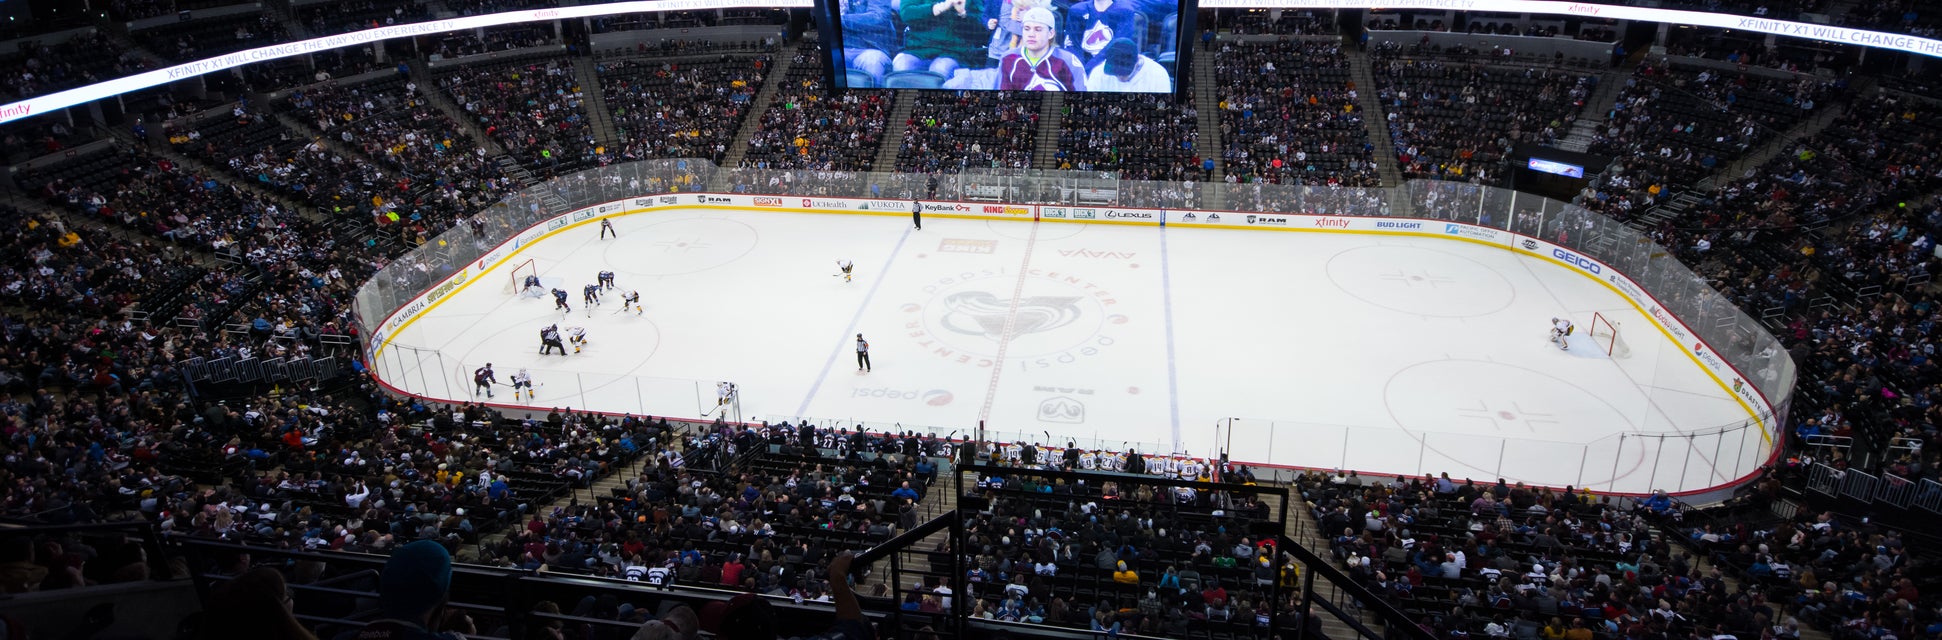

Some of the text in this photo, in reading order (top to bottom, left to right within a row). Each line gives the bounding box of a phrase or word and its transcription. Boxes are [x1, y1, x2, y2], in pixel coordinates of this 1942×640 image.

[1568, 4, 1601, 16] xfinity
[1738, 18, 1942, 54] XFINITY X1 WILL CHANGE THE
[167, 20, 454, 79] XFINITY X1 WILL CHANGE THE WAY YOU EXPERIENCE TV
[0, 104, 31, 120] finity
[812, 200, 847, 208] UCHealth
[870, 201, 905, 209] VUKOTA
[925, 204, 955, 213] KeyBank
[1315, 216, 1351, 229] xfinity
[1376, 221, 1422, 230] BUD LIGHT
[1460, 230, 1495, 239] AUTOMATION
[1057, 248, 1137, 260] AVAYA
[1553, 248, 1601, 275] GEICO
[922, 266, 1118, 307] pepsi CENTER
[392, 301, 426, 328] CAMBRIA
[1669, 324, 1683, 341] LIGHT
[904, 320, 1114, 372] pepsi CENTER
[851, 386, 919, 400] pepsi
